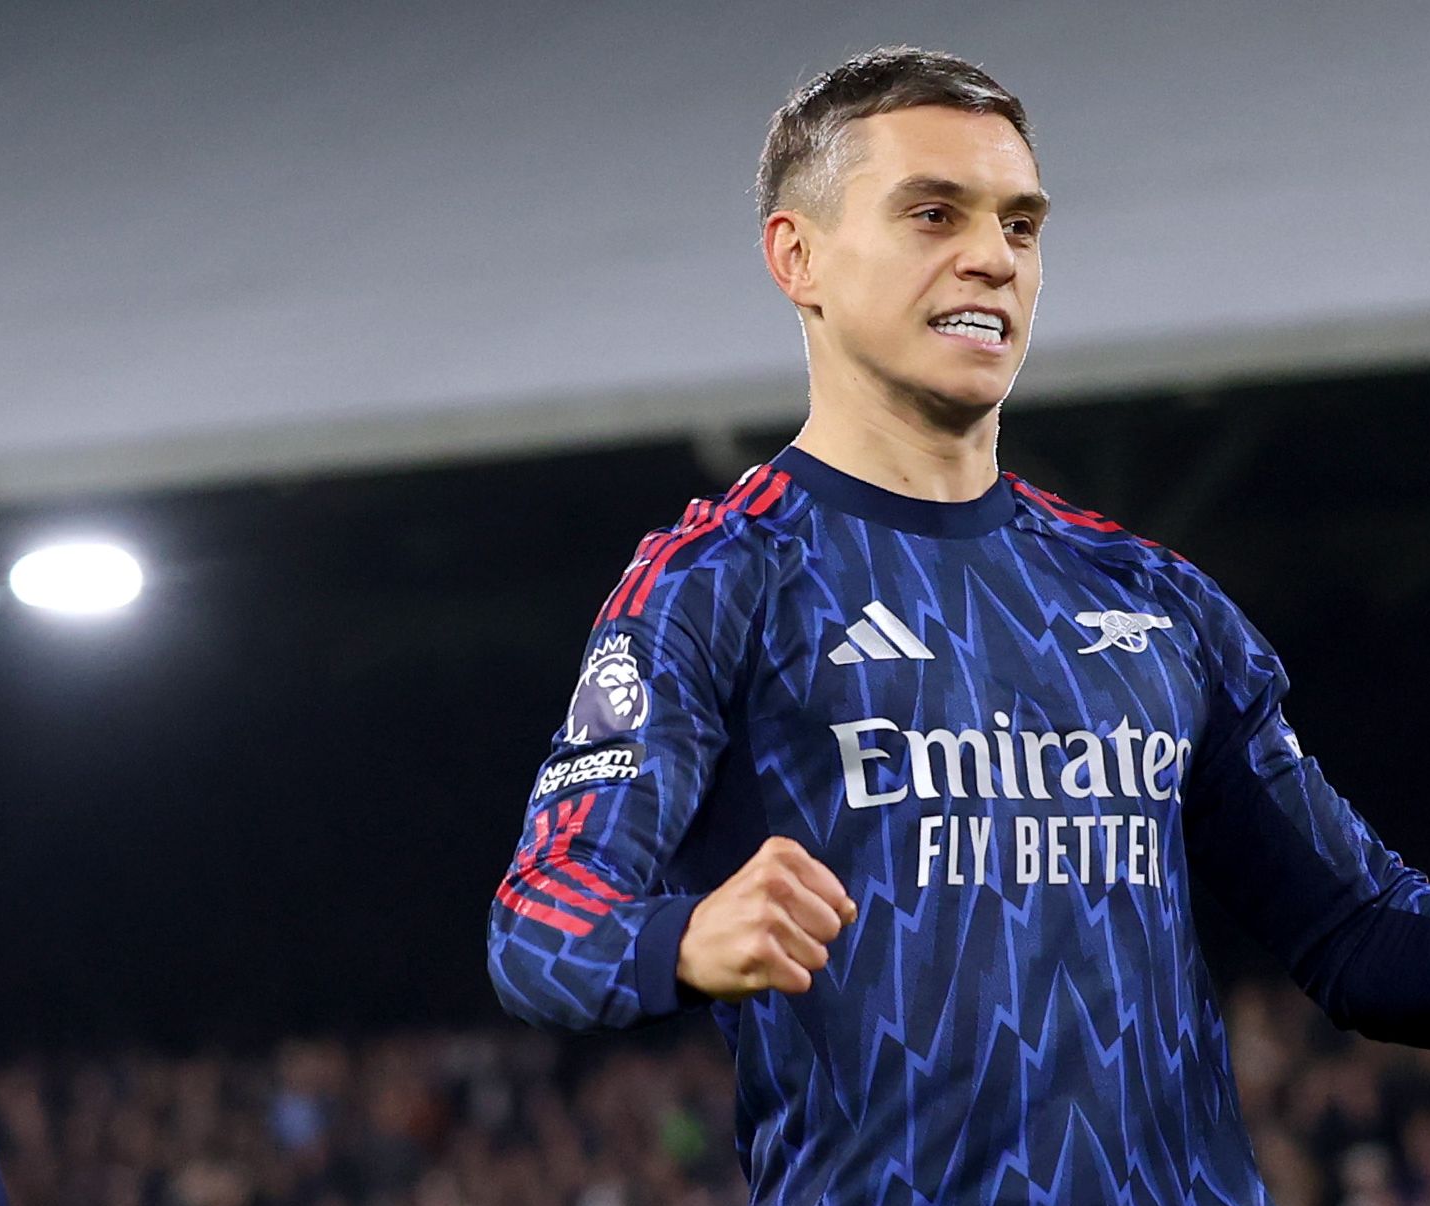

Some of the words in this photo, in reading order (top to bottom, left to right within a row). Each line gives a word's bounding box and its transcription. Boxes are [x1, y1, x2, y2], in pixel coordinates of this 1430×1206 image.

[535, 776, 566, 800] for
[562, 765, 639, 787] racism
[539, 762, 572, 783] No
[571, 749, 633, 773] room
[917, 815, 991, 888] FLY
[1015, 815, 1160, 888] BETTER
